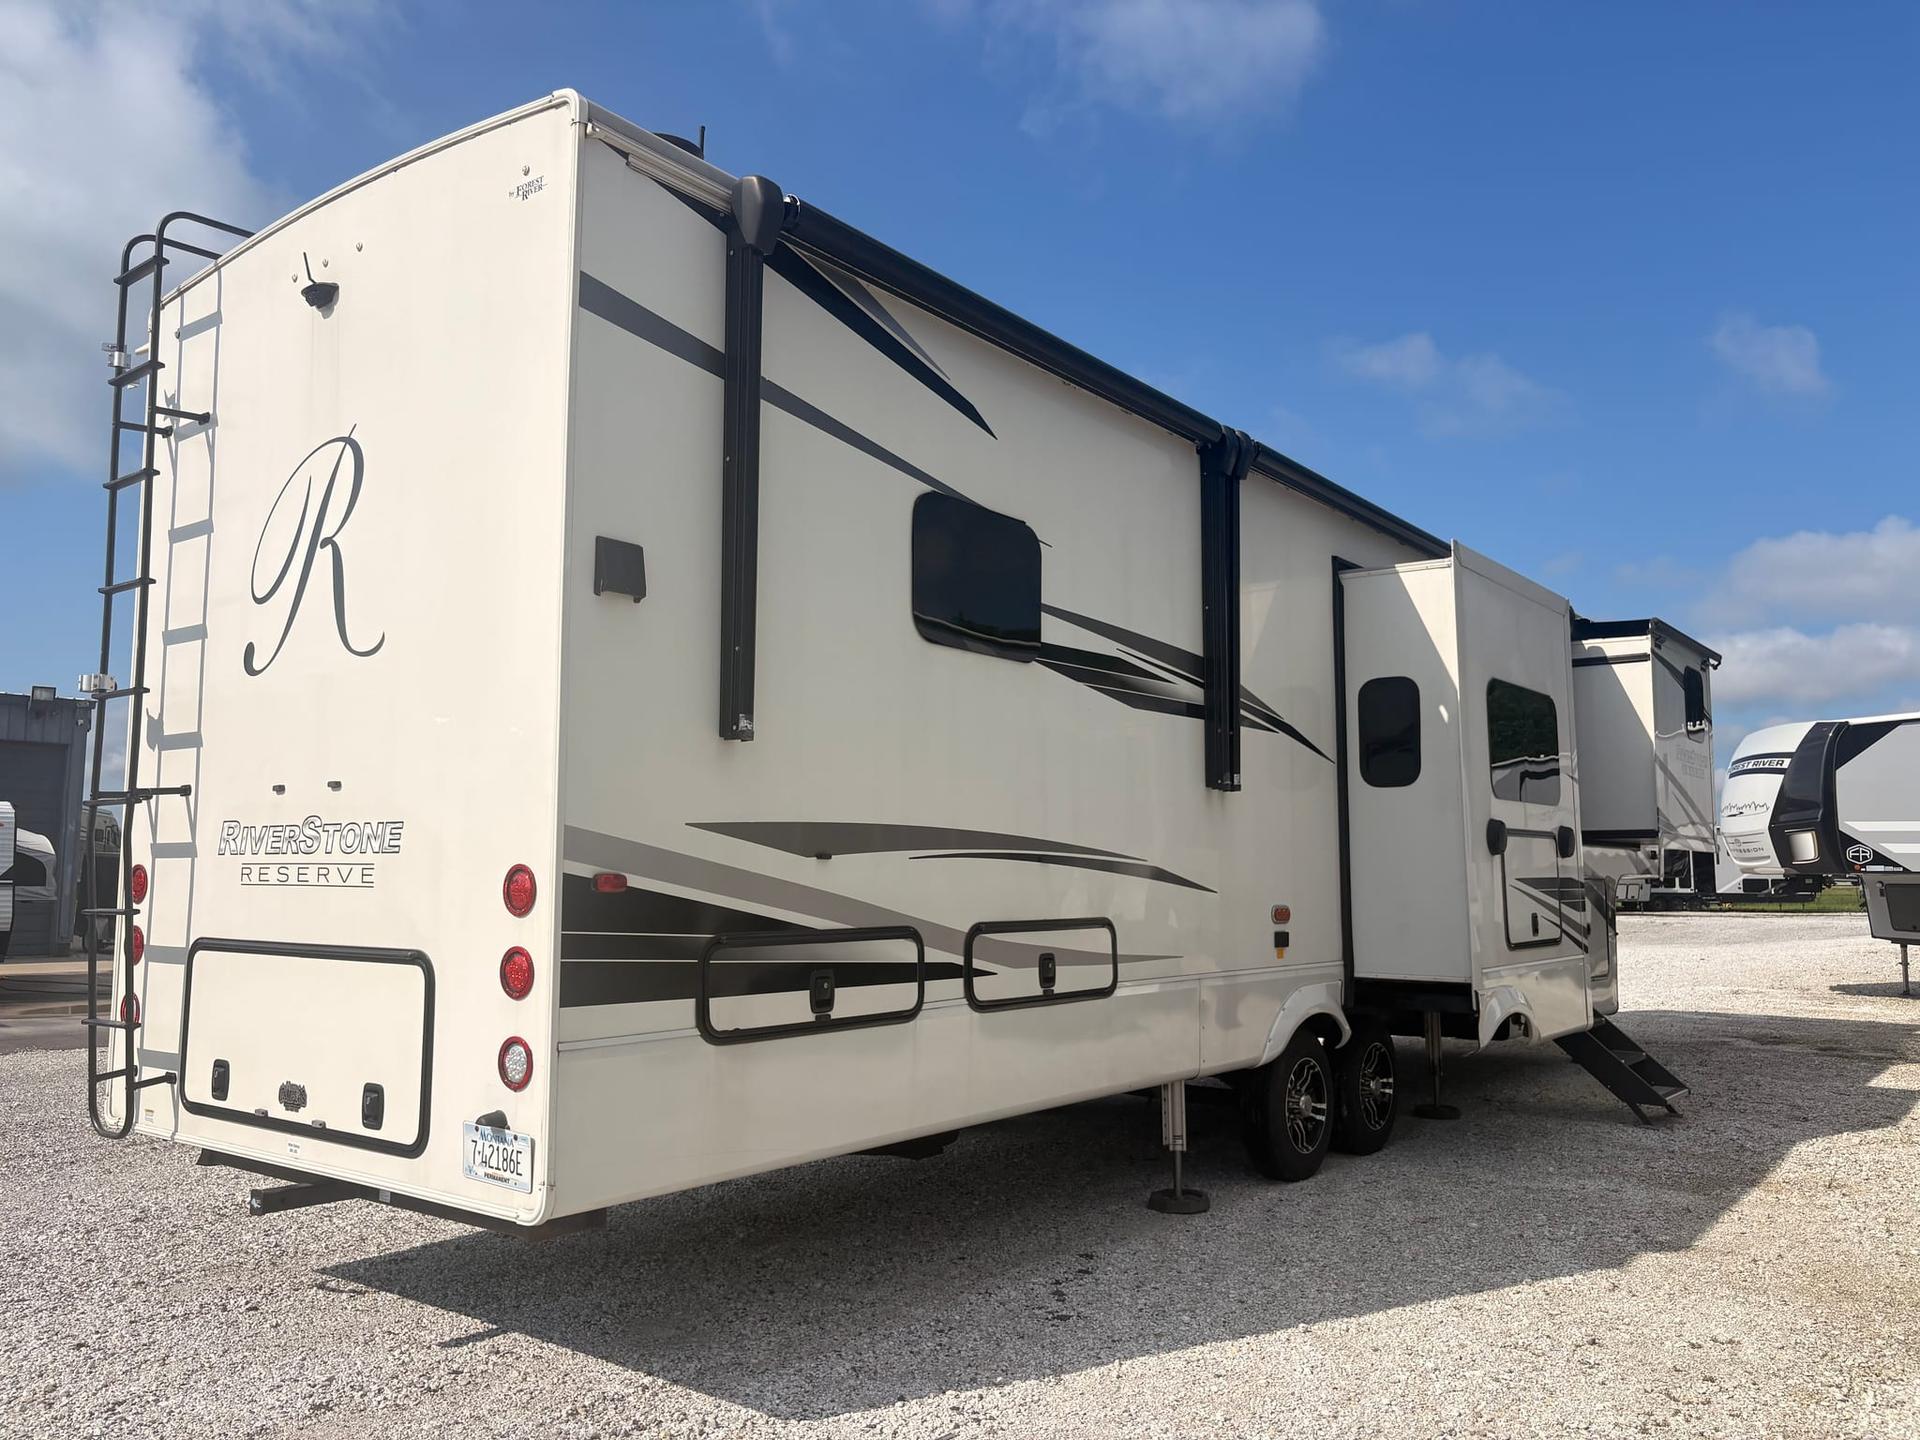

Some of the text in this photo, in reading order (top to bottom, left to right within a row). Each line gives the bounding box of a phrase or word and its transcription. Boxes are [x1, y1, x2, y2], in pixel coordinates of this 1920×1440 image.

[515, 175, 544, 197] FOREST
[522, 183, 543, 200] RIVER
[1751, 759, 1785, 767] RIVER
[241, 866, 374, 883] RESERVE
[479, 1129, 514, 1147] MONTANA
